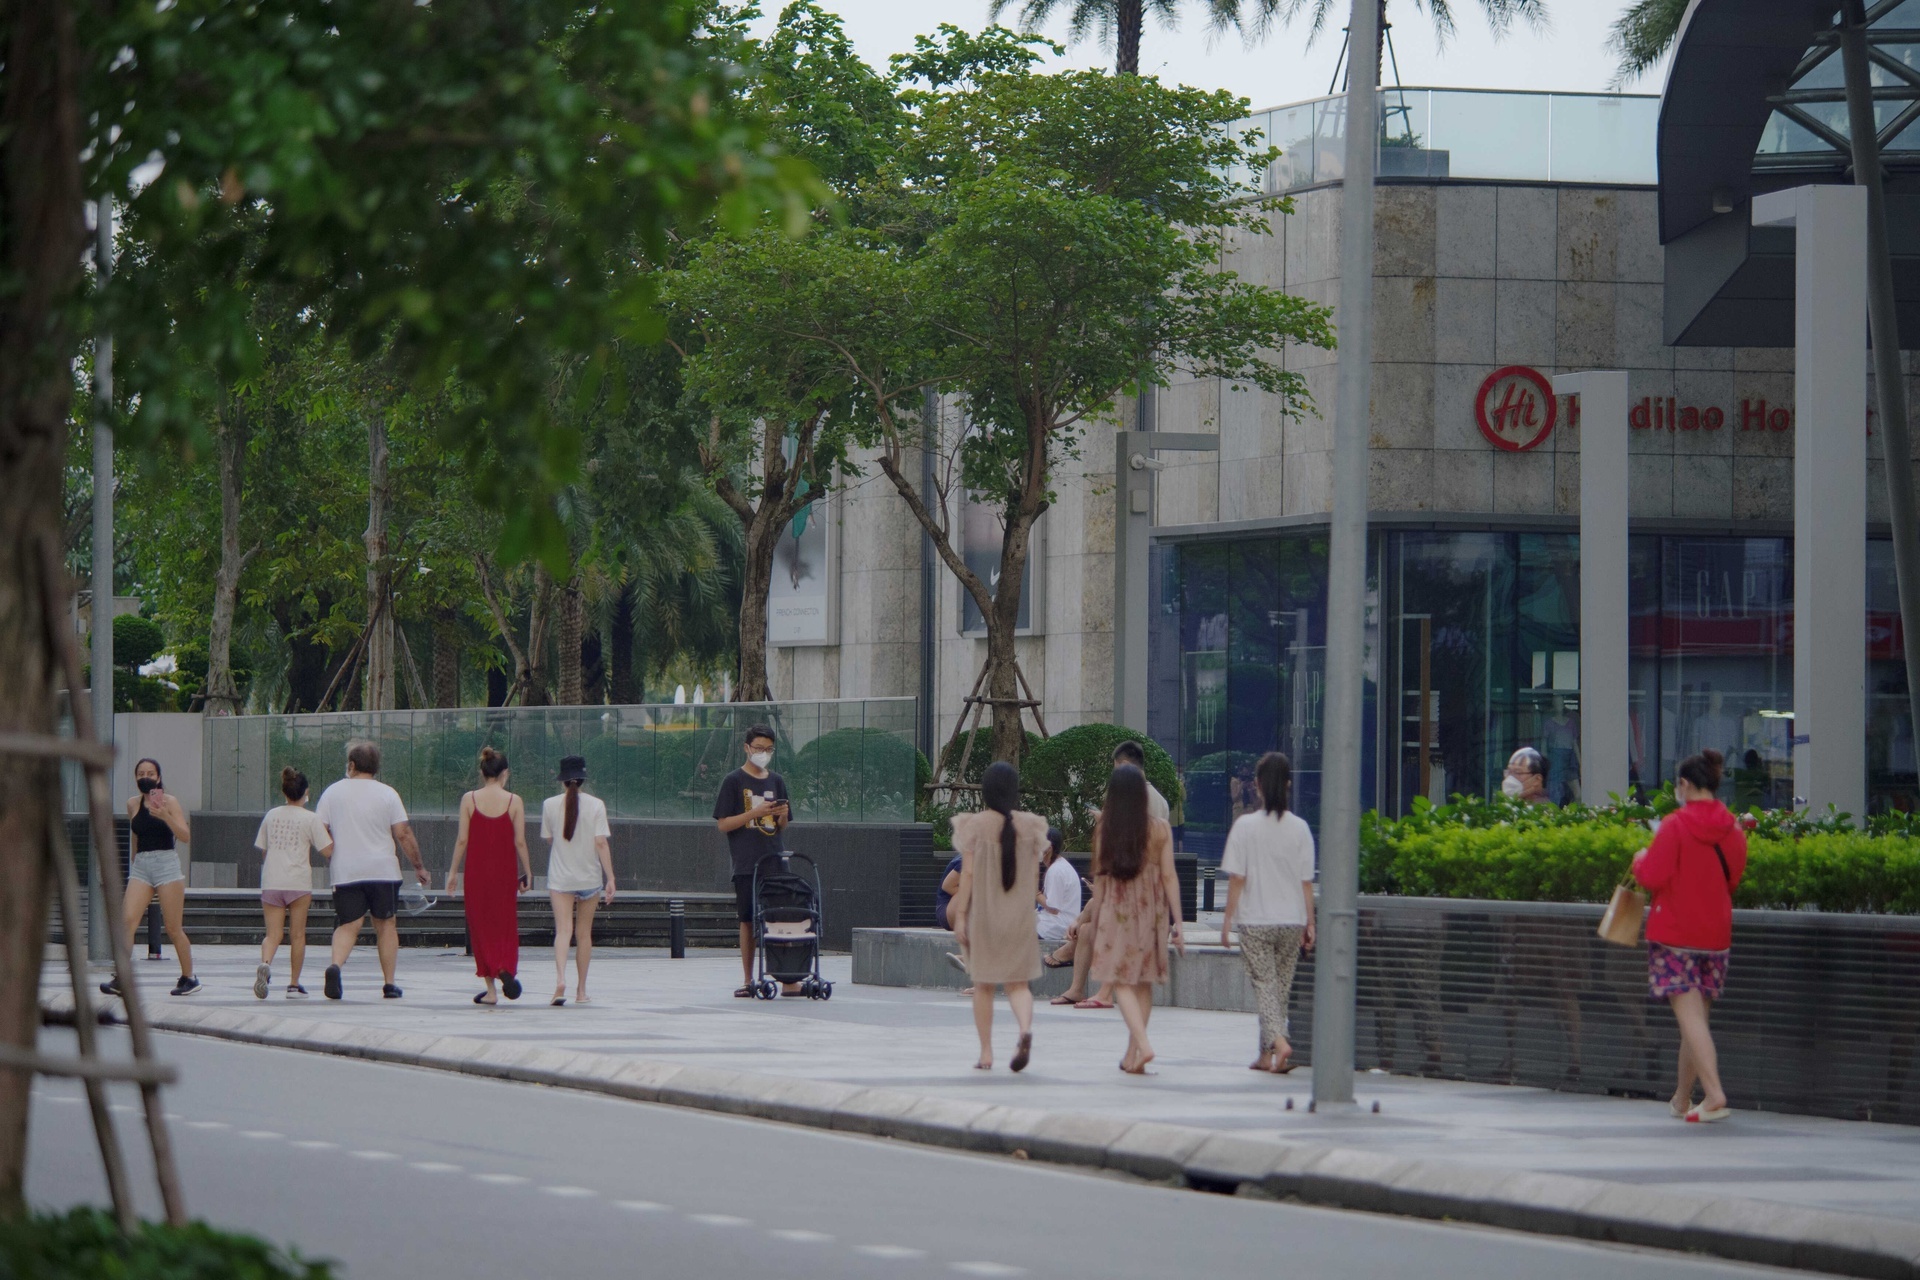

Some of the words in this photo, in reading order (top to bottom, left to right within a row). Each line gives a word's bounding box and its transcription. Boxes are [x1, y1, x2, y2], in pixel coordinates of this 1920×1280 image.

[1492, 381, 1539, 432] Hi
[1568, 395, 1724, 432] Hdilao
[1696, 569, 1756, 619] GAP
[1196, 699, 1217, 744] GAP
[1292, 670, 1319, 728] GAP
